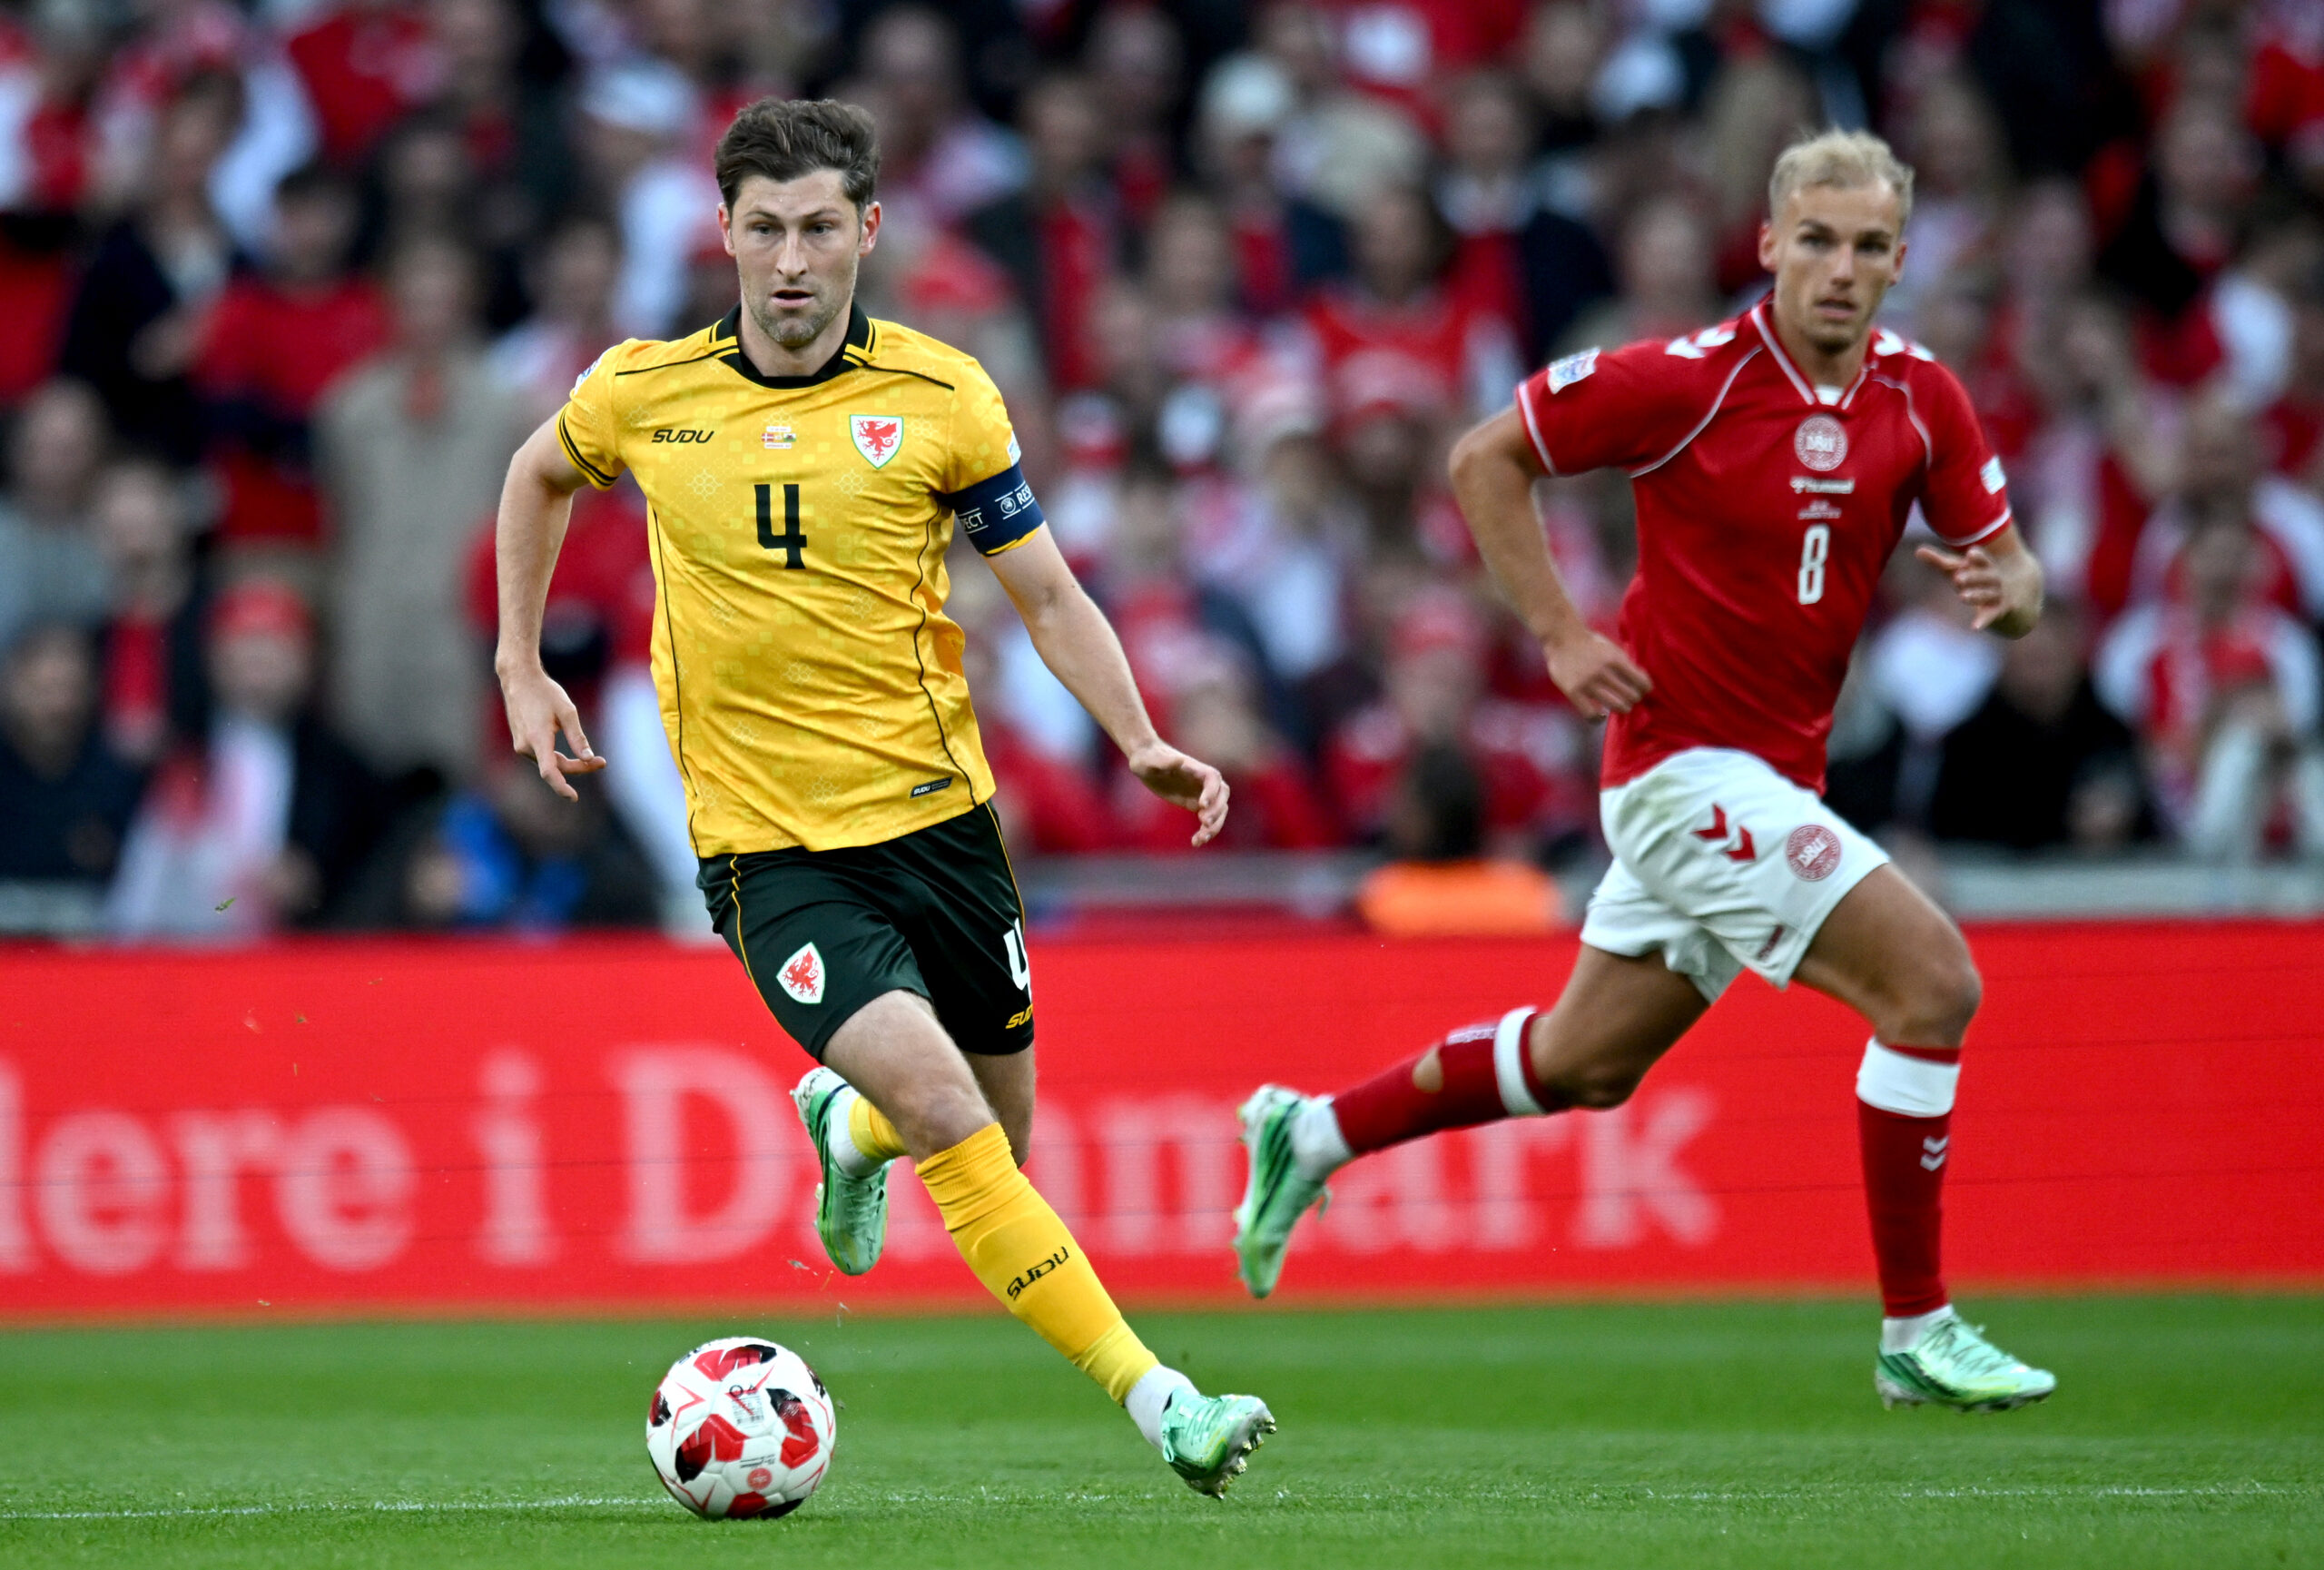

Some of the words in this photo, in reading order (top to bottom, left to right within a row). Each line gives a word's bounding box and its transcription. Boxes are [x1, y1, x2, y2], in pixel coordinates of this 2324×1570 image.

[651, 429, 714, 443] SUDU
[753, 483, 807, 569] 4
[1797, 523, 1831, 606] 8
[474, 1045, 554, 1266] i
[1007, 1246, 1069, 1300] SUDU
